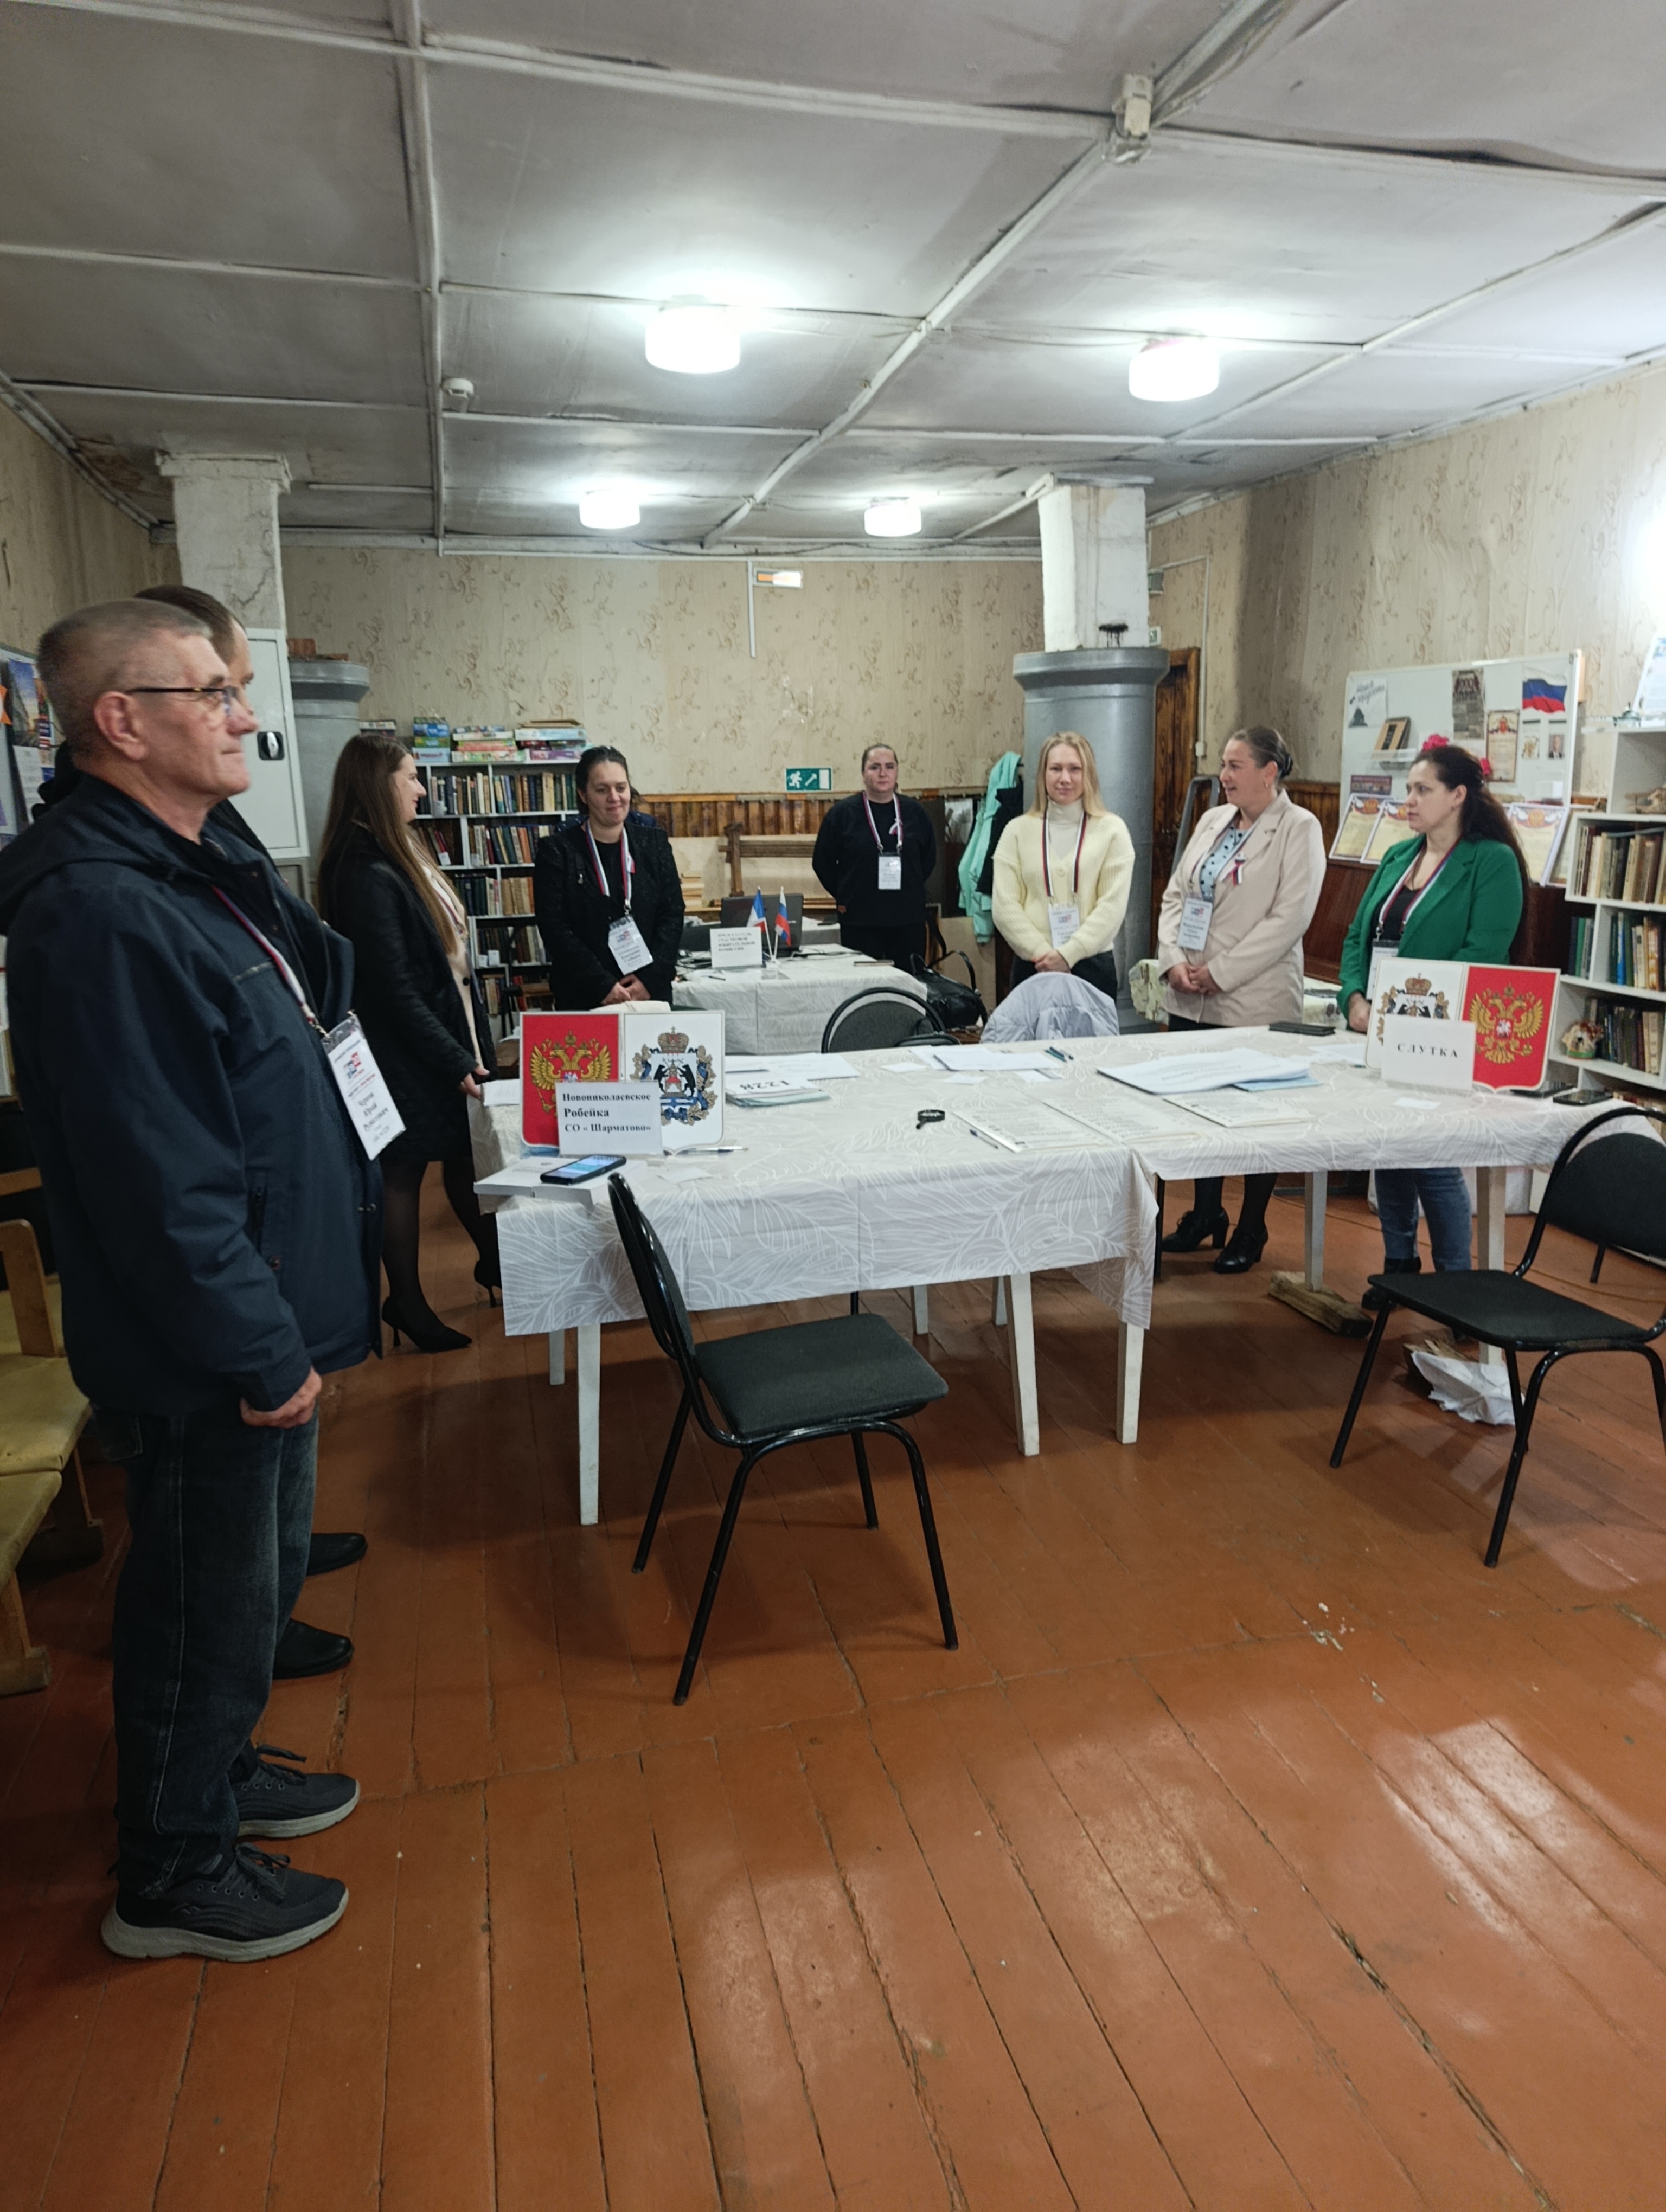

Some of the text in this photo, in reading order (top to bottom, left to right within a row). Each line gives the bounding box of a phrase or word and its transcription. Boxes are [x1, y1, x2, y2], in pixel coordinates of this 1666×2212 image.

[1397, 1043, 1458, 1058] СЛУТКА
[562, 1093, 651, 1101] Новониколаевское
[564, 1108, 610, 1117] Робейка
[565, 1124, 580, 1132] СО
[591, 1123, 651, 1134] Шарматово»
